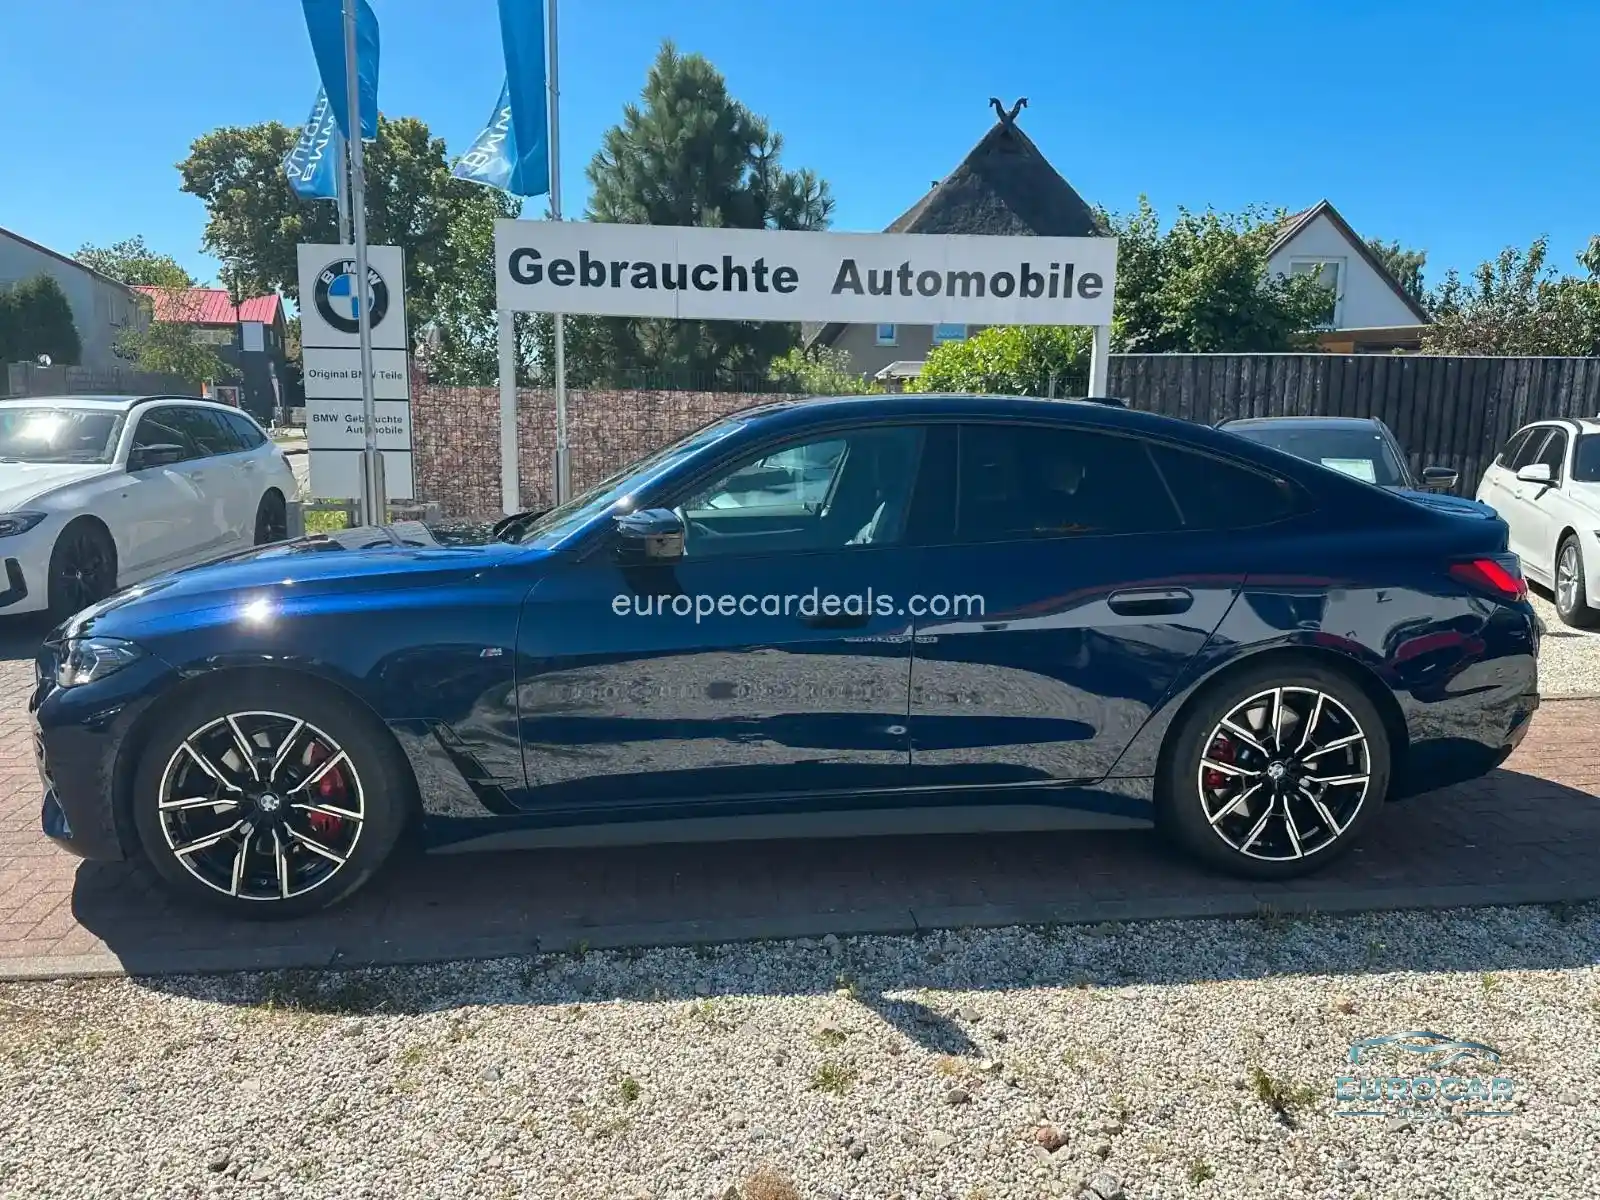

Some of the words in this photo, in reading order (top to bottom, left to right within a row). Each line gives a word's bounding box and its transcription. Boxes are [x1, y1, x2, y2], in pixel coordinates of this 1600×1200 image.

[321, 261, 381, 285] BMW
[508, 247, 799, 293] Gebrauchte
[831, 258, 1103, 299] Automobile
[309, 369, 348, 380] Original
[380, 371, 403, 380] Teile
[313, 414, 339, 422] BMW
[345, 414, 403, 423] Gebuchte
[346, 425, 403, 434] Autobile
